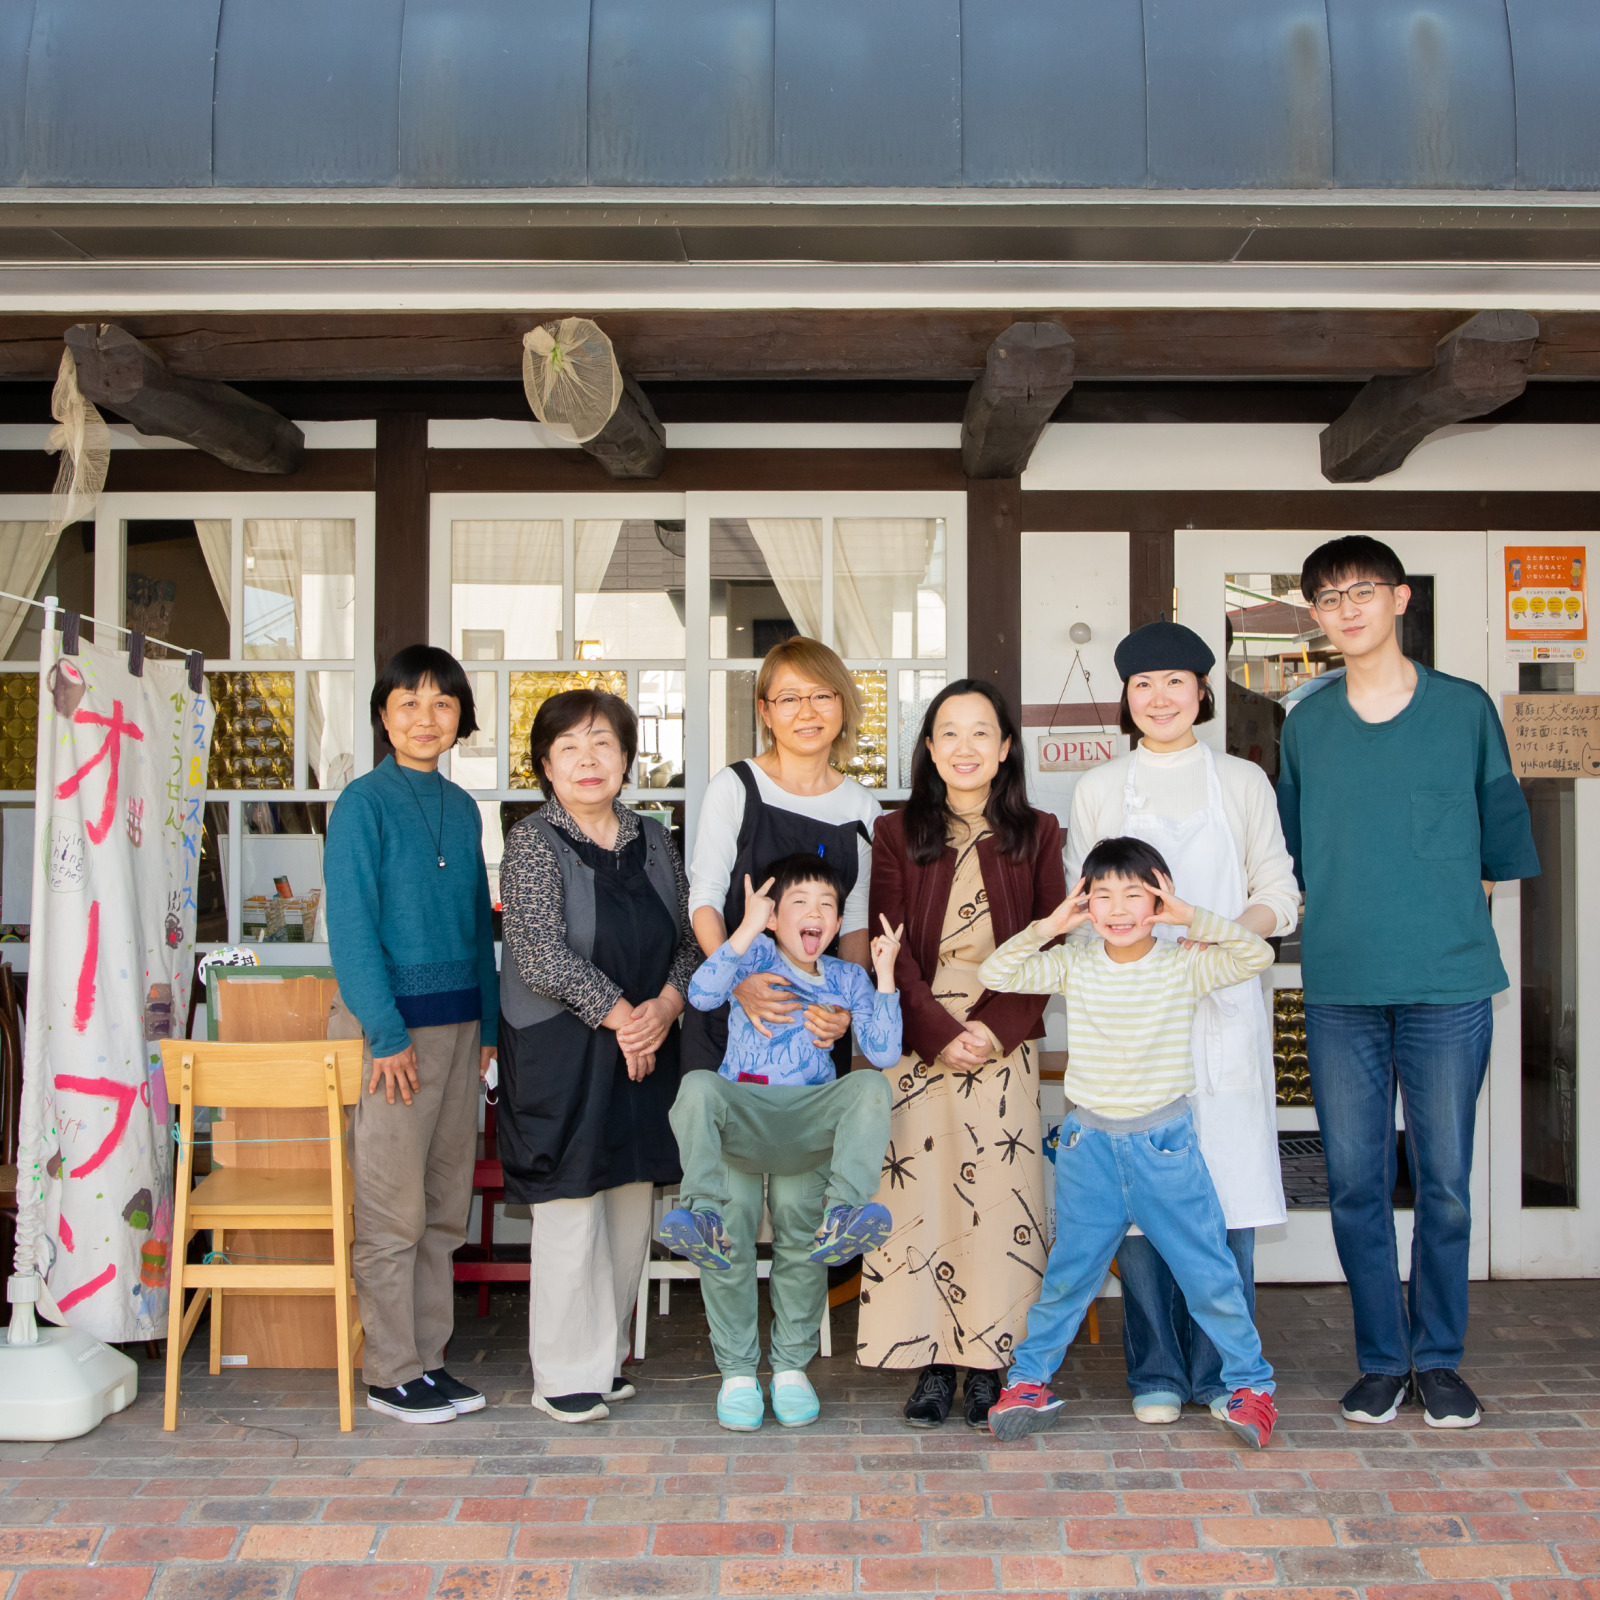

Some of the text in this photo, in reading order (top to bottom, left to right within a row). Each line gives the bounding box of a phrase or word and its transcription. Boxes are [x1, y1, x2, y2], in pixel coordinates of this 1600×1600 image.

[164, 692, 186, 831] ひこうせん
[1043, 741, 1112, 762] OPEN
